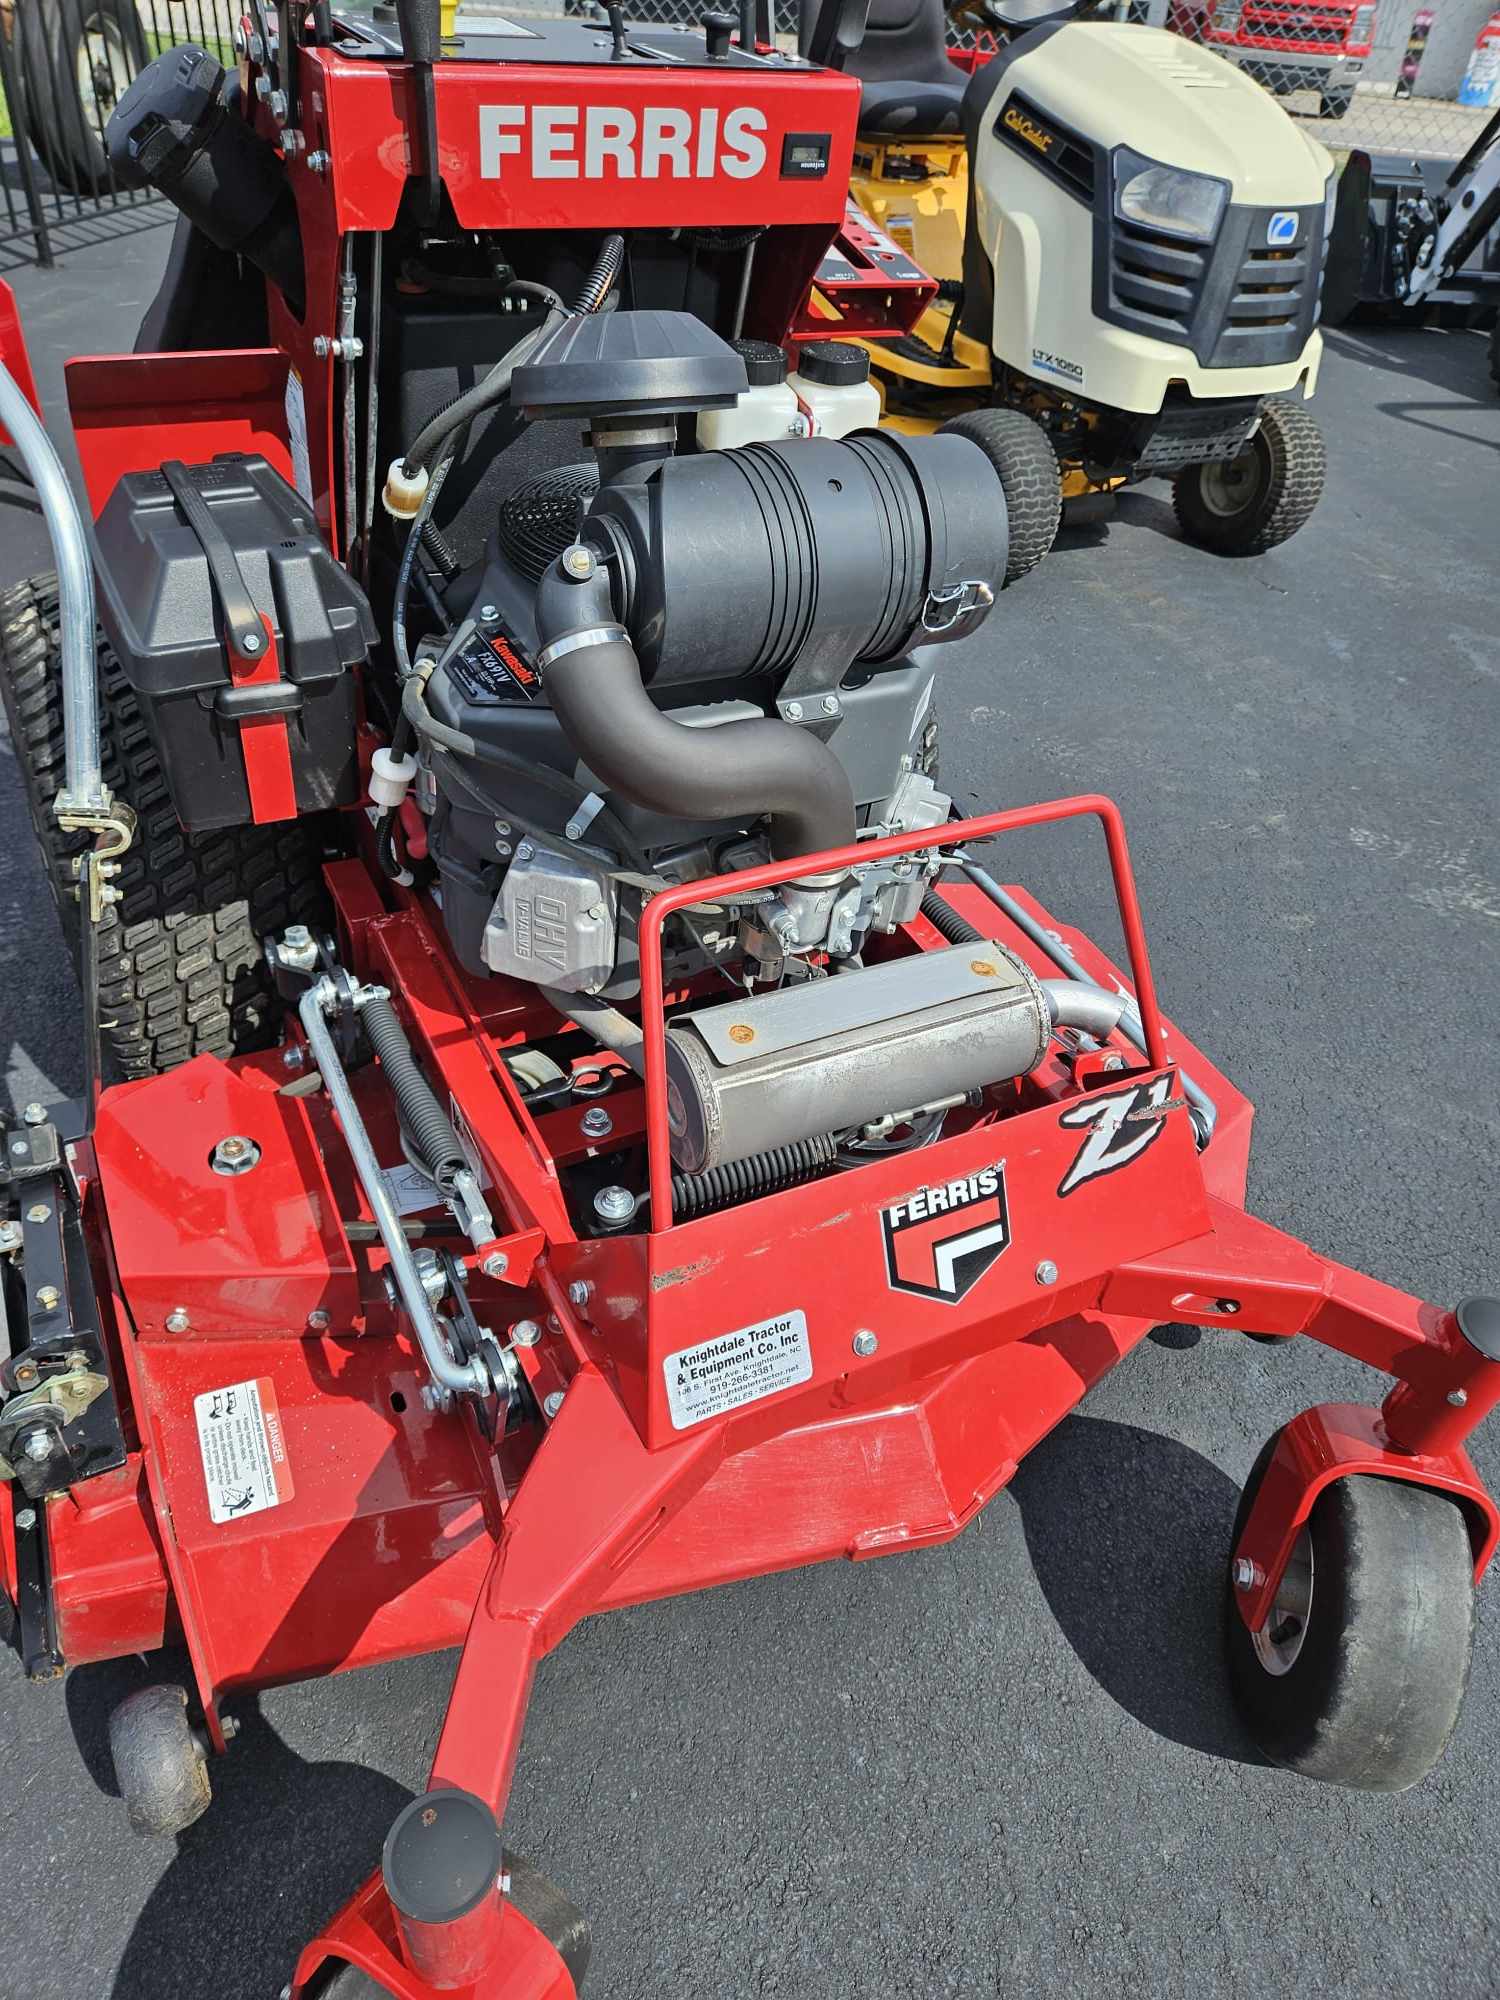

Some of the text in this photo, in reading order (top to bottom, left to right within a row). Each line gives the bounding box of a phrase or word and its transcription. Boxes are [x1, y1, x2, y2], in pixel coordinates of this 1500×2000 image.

[479, 105, 768, 179] FERRIS
[490, 636, 534, 685] Kawasaki
[534, 894, 567, 972] OHV
[1060, 1072, 1176, 1197] Z1
[889, 1170, 999, 1228] FERRIS
[677, 1334, 798, 1385] & Equipment Co. Inc
[680, 1321, 790, 1368] Knightdale Tractor
[704, 1375, 722, 1386] First
[790, 1345, 800, 1353] NC
[696, 1376, 791, 1417] PARTS SALES SERVICE
[710, 1364, 773, 1393] 919-266-3381
[268, 1421, 283, 1463] DANGER
